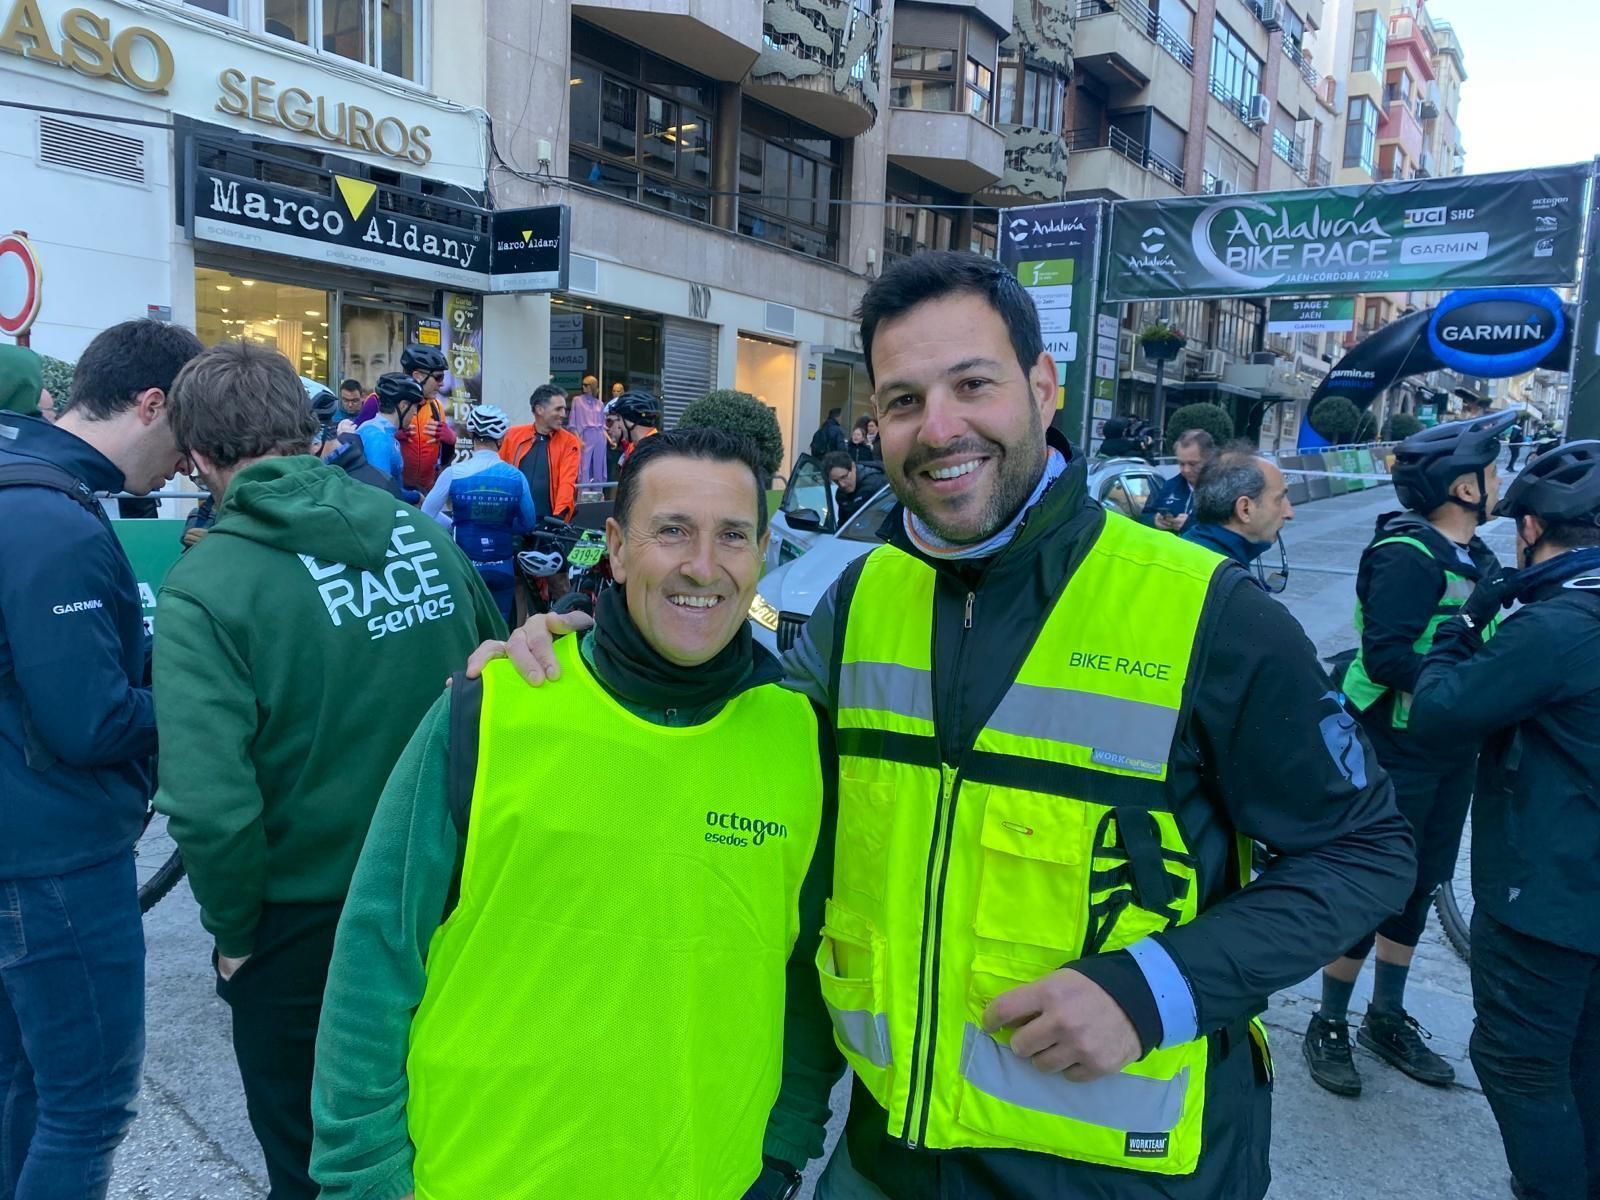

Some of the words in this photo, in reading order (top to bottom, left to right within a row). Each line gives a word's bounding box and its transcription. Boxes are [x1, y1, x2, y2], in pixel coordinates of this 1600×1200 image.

[0, 0, 175, 93] ASO
[216, 67, 432, 165] SEGUROS
[209, 177, 344, 235] Marco
[362, 217, 477, 267] Aldany
[1226, 201, 1392, 246] Andalucía
[1411, 210, 1443, 224] UCI
[1450, 208, 1475, 220] SHC
[1032, 217, 1086, 235] Andalucía
[497, 240, 525, 250] Marco
[527, 237, 559, 249] Aldany
[1410, 241, 1479, 256] GARMIN
[1226, 243, 1295, 271] BIKE
[1302, 237, 1393, 269] RACE
[1365, 270, 1389, 280] 2024
[1293, 301, 1320, 310] STAGE
[1323, 301, 1329, 309] 2
[454, 310, 465, 327] 9
[1299, 311, 1322, 320] JAÉN
[1442, 324, 1542, 342] GARMIN
[454, 357, 465, 375] 9
[1331, 368, 1376, 380] garmin.es
[318, 552, 449, 627] RACE
[53, 600, 103, 615] GARMIN
[367, 595, 455, 640] series
[1069, 652, 1112, 671] BIKE
[1115, 657, 1172, 681] RACE
[706, 811, 787, 846] octagon
[704, 832, 748, 848] esedos
[1129, 1138, 1165, 1149] WORKTEAM
